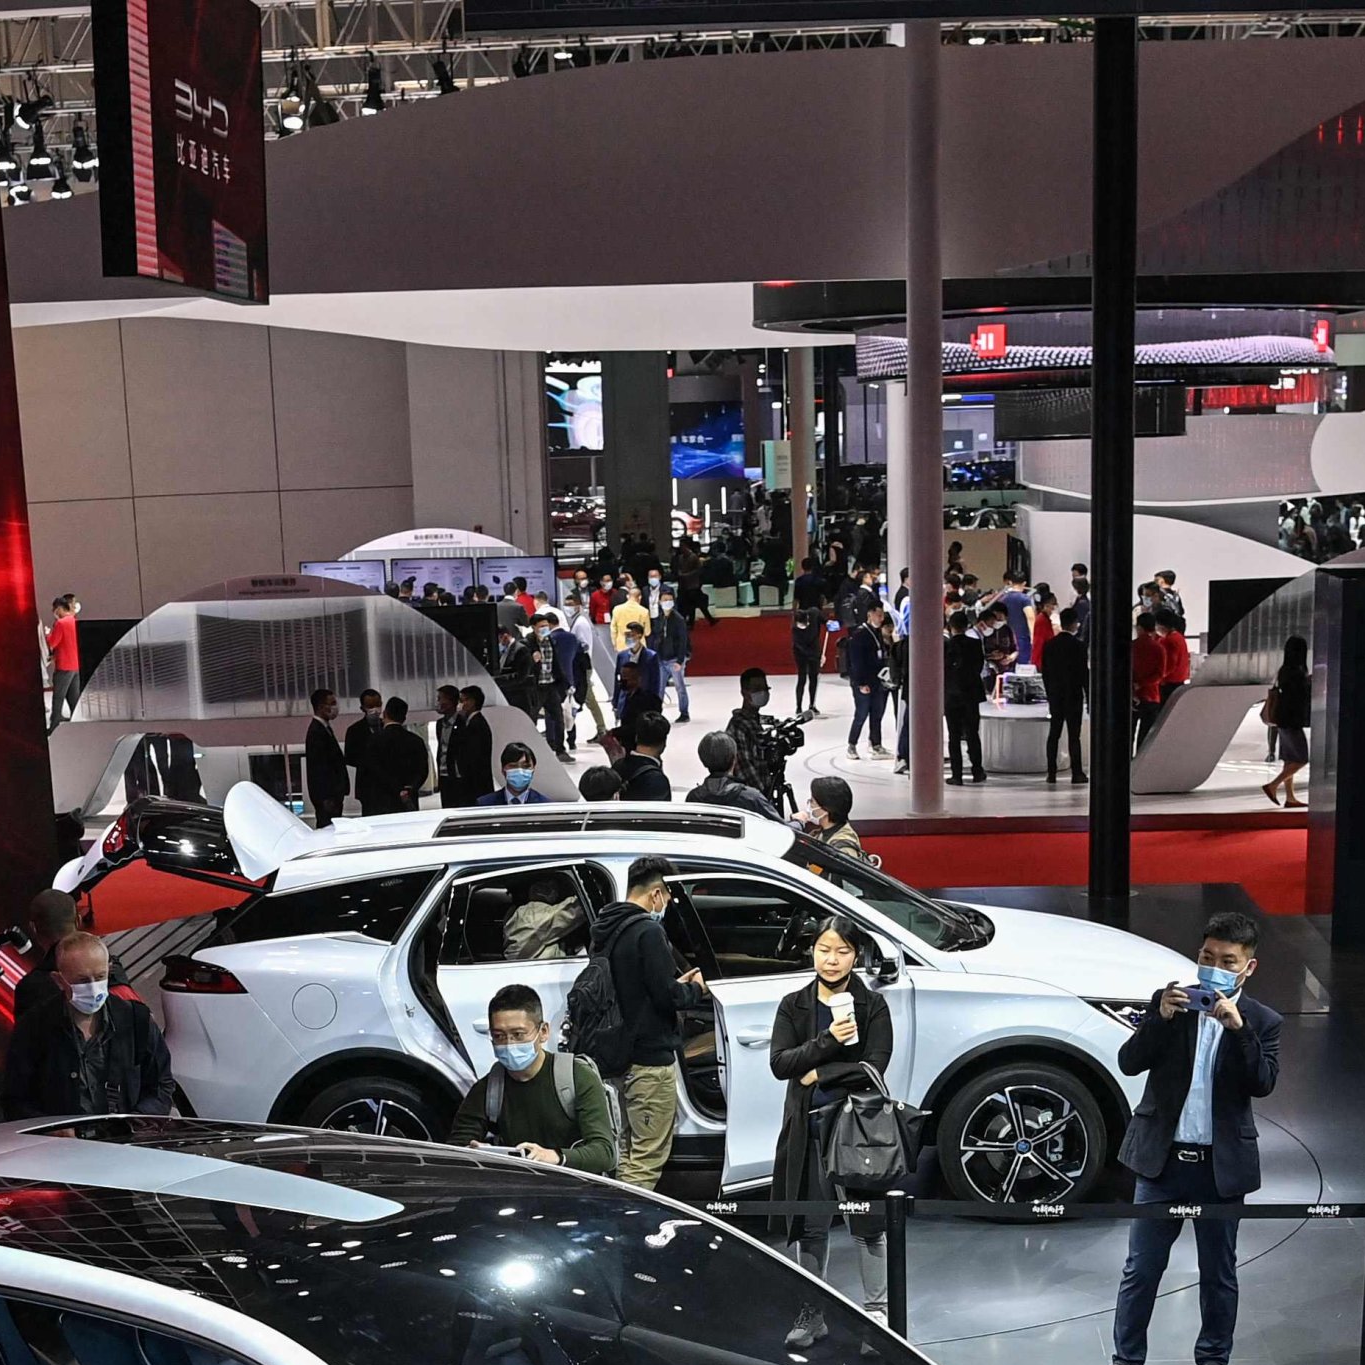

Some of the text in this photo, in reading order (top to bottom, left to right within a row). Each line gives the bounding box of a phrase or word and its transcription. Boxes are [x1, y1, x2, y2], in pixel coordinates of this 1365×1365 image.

[175, 78, 229, 139] BYD
[176, 132, 231, 184] 比亚迪汽车
